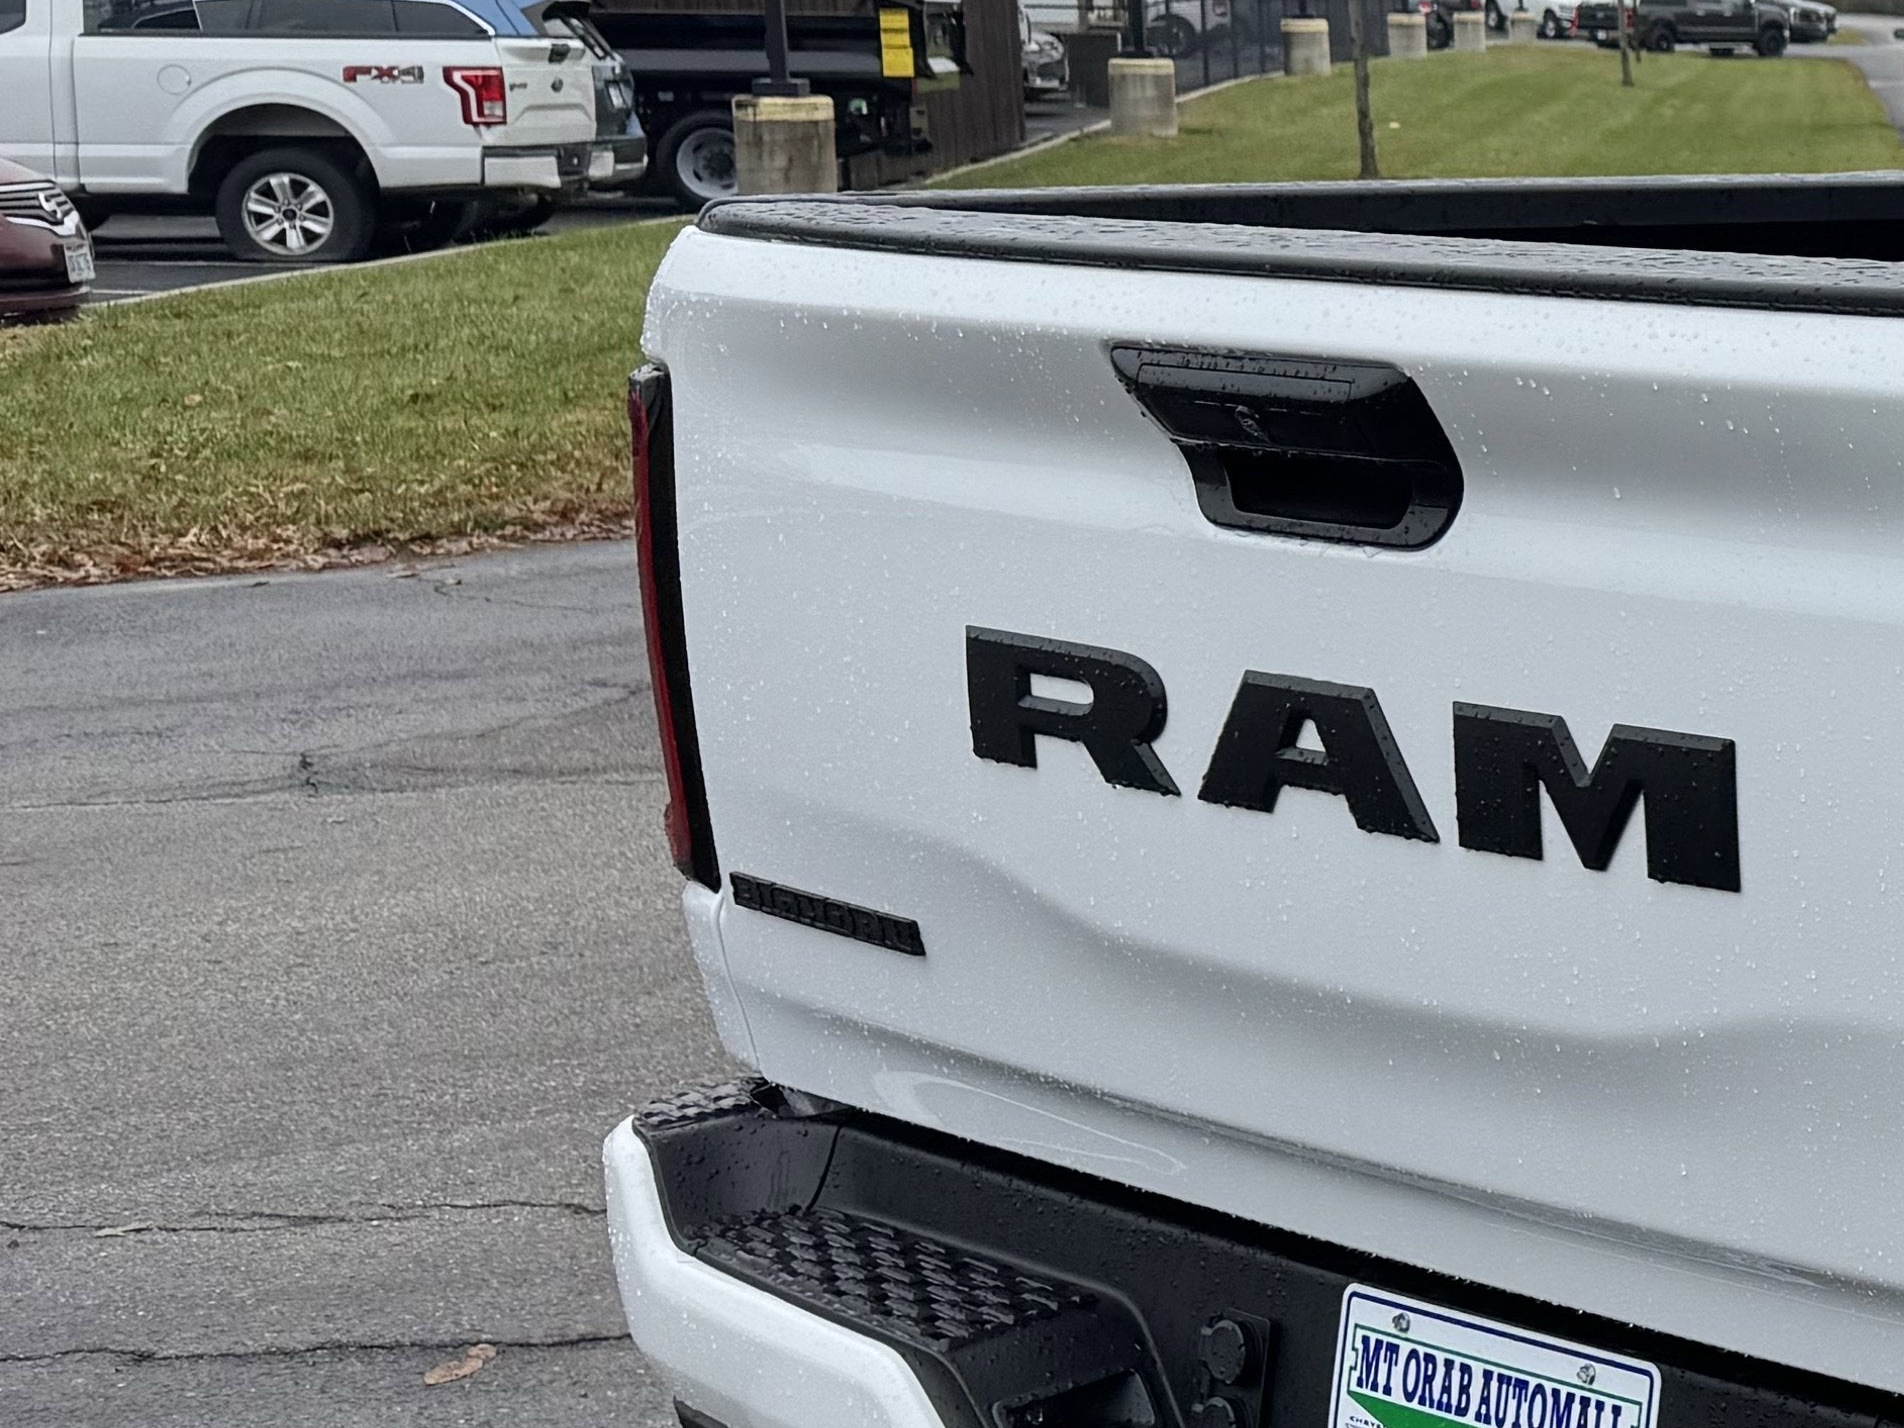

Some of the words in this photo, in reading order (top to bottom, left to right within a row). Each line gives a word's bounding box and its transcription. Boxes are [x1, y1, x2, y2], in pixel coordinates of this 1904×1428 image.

[342, 66, 424, 84] FX4
[966, 624, 1742, 893] RAM
[1356, 1334, 1400, 1397] MT
[1402, 1347, 1473, 1418] ORAB
